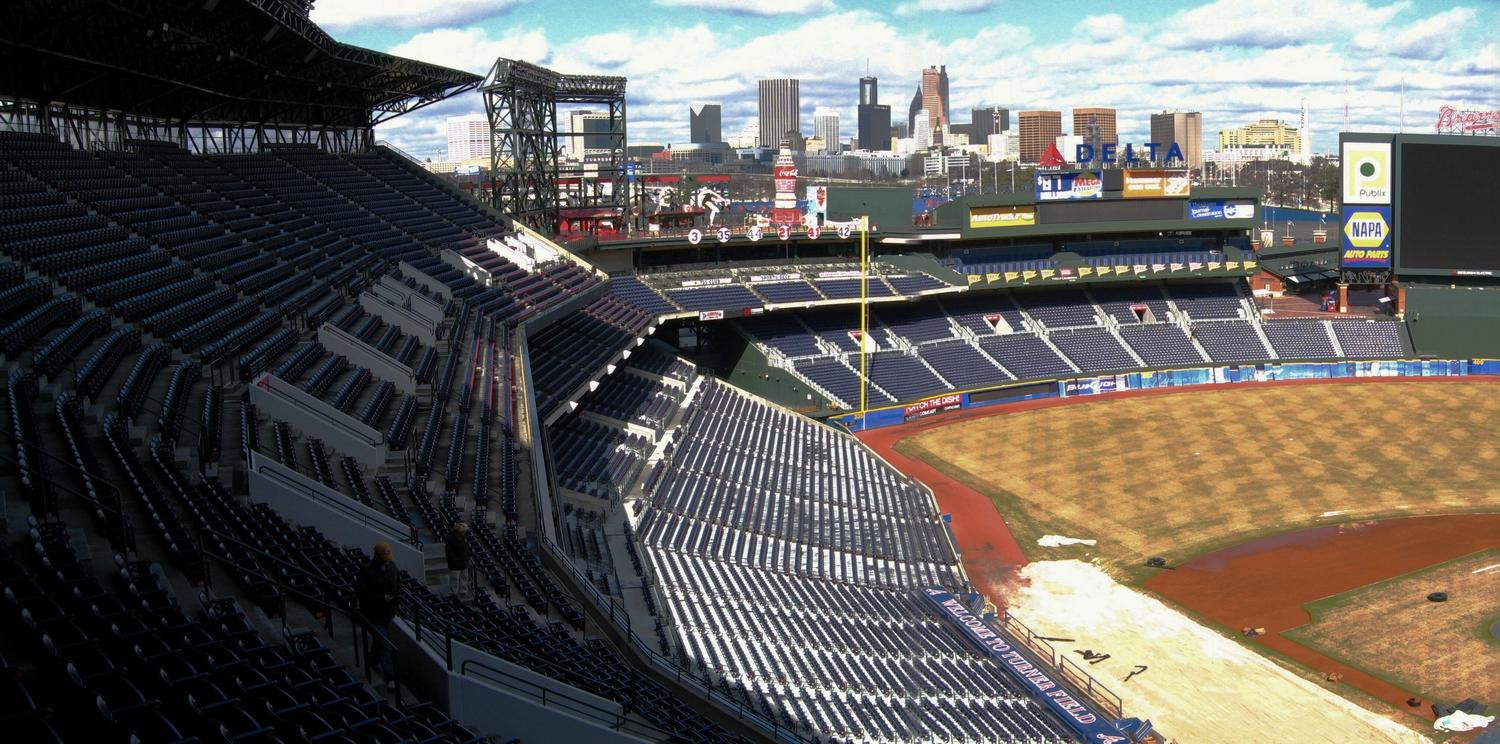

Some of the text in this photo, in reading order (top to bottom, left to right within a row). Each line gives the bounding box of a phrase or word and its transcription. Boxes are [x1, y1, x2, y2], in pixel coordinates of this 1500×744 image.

[1076, 142, 1184, 162] DELTA
[1360, 188, 1386, 197] Publix
[717, 230, 730, 240] 35
[747, 229, 763, 240] 44
[779, 227, 790, 238] 21
[808, 227, 820, 237] 41
[837, 226, 850, 237] 42
[1352, 222, 1382, 237] NAPA
[1344, 250, 1389, 259] AUTO PARTS
[930, 398, 941, 406] THE
[941, 598, 1097, 725] WELCOME TO TURNER FIELD
